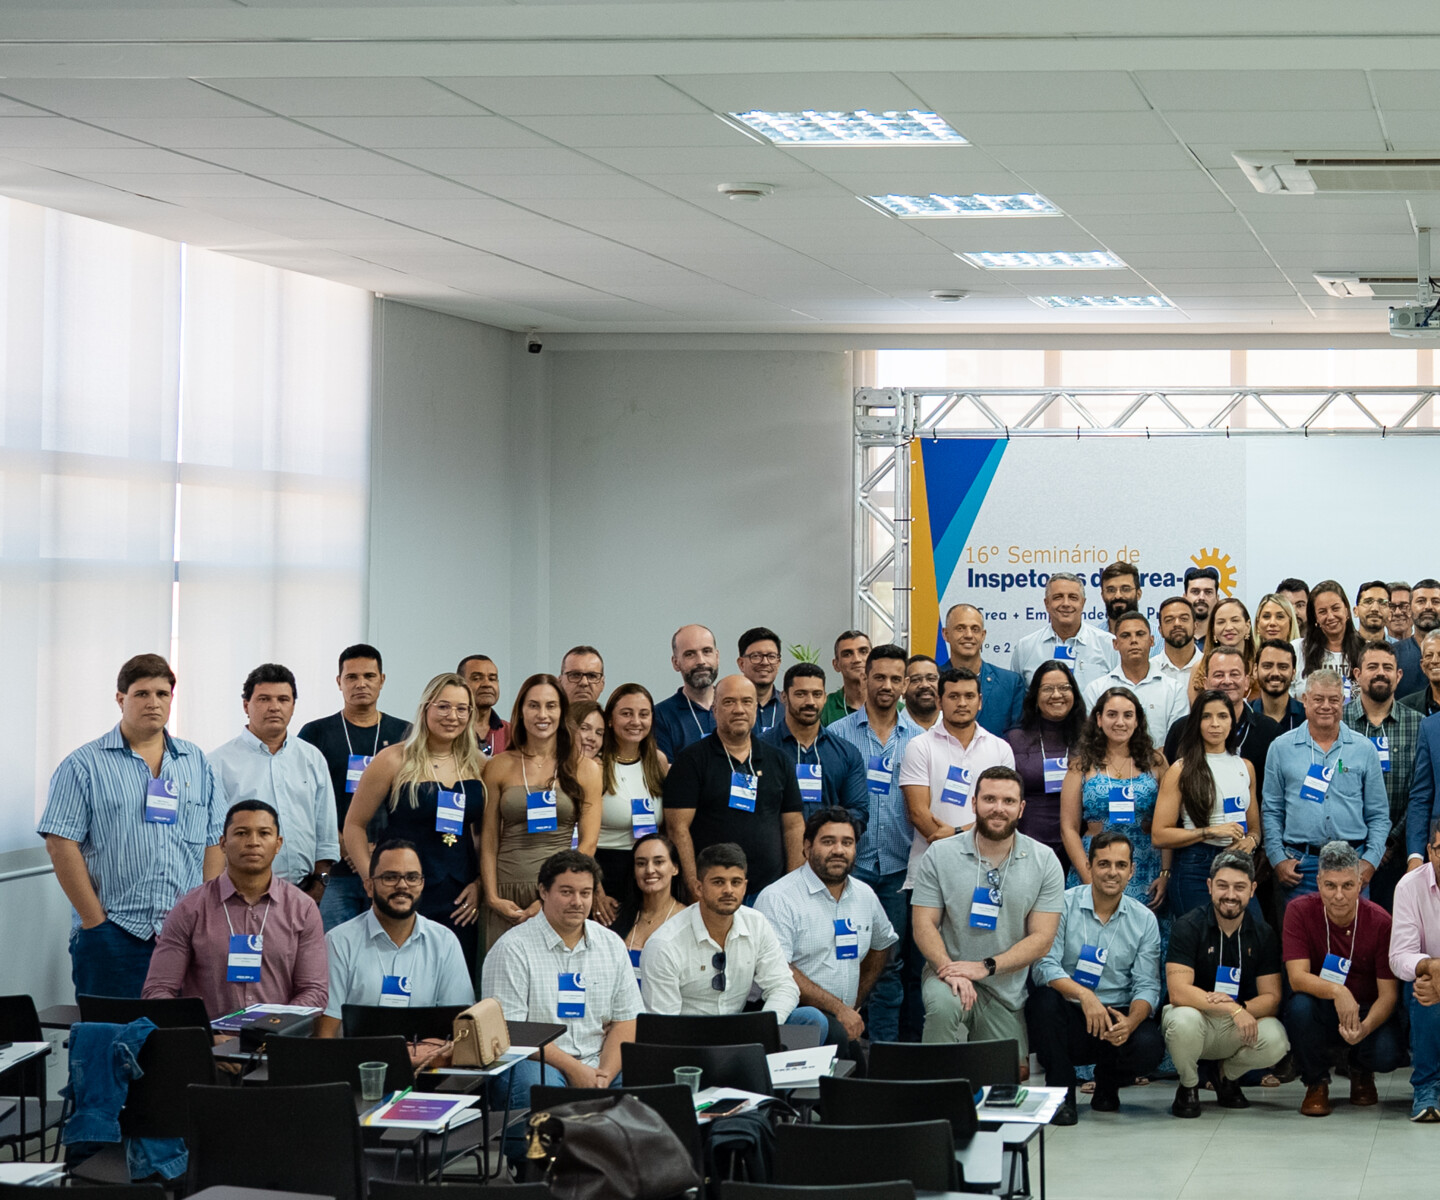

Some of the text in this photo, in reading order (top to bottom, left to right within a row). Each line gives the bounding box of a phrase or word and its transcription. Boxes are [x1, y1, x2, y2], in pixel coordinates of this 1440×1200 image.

[1008, 544, 1108, 564] Seminário
[1116, 545, 1140, 563] de
[993, 645, 1001, 653] e
